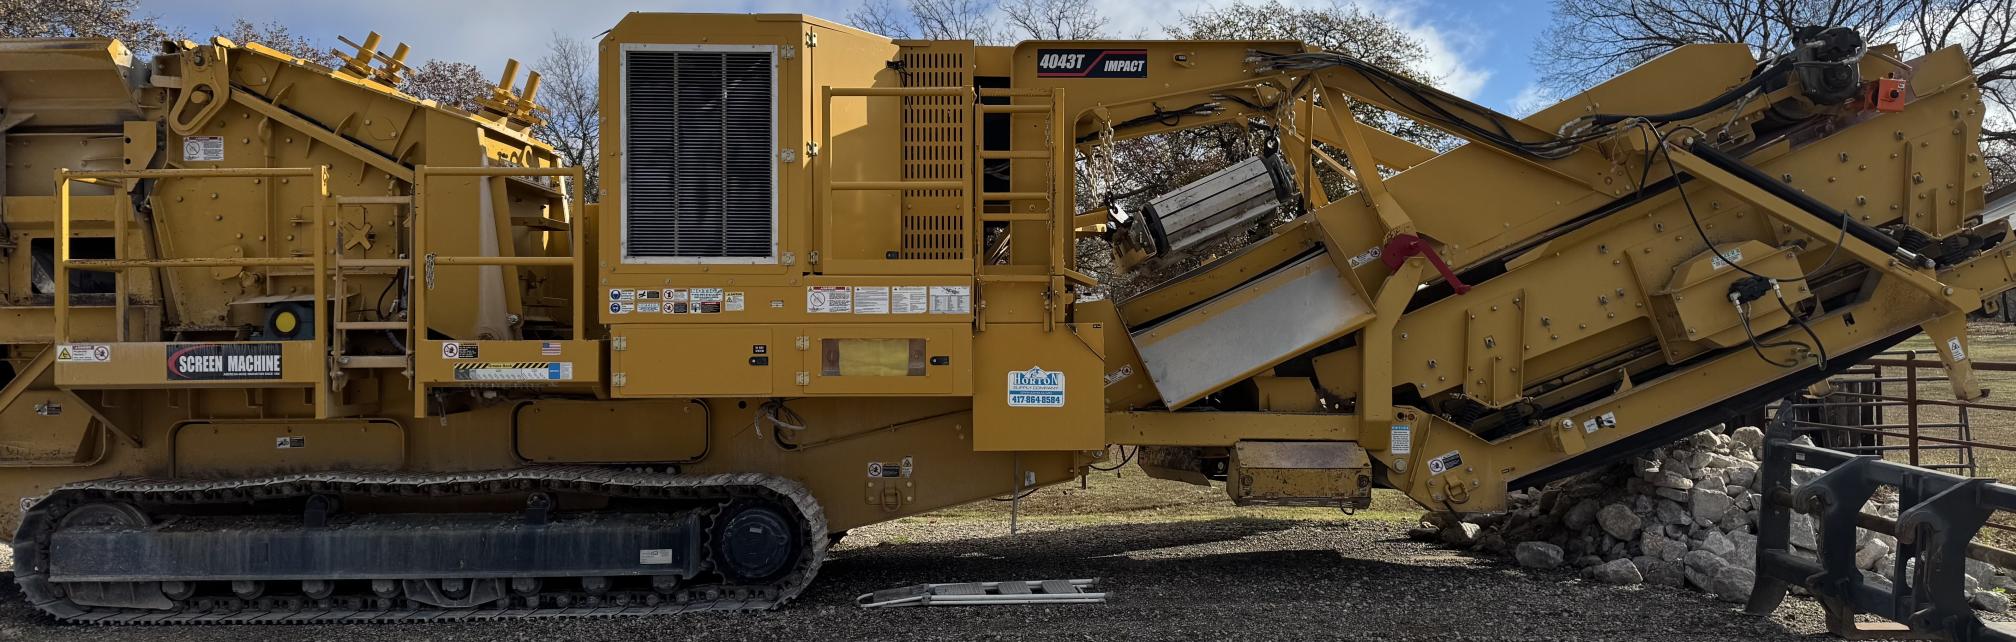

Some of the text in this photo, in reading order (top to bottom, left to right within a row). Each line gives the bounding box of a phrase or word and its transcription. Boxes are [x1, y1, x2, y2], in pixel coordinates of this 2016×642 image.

[1040, 54, 1145, 72] 4043T IMPACT
[179, 355, 280, 373] SCREEN MACHINE
[1013, 372, 1058, 385] HORTON
[1012, 395, 1060, 404] 417-864-8584
